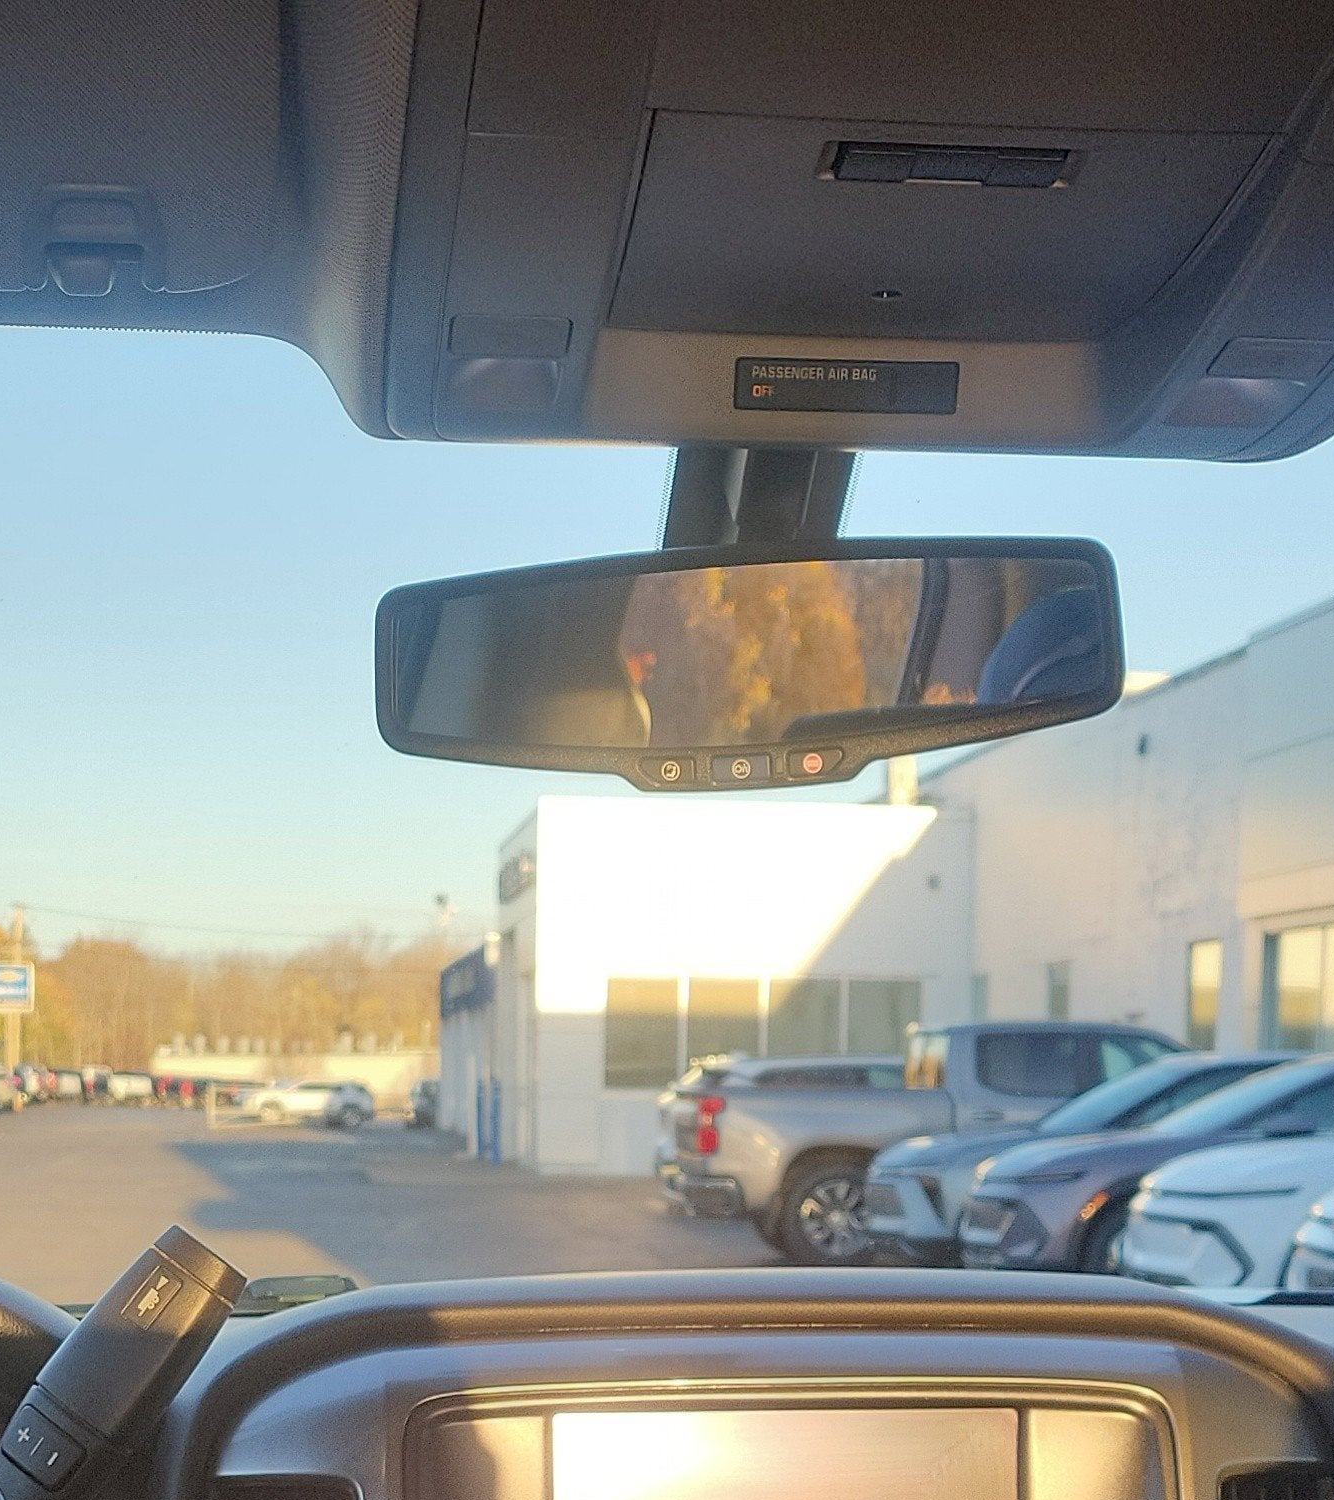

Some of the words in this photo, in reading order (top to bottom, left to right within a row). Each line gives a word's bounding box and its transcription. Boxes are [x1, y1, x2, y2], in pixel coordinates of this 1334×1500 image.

[752, 365, 823, 381] PASSENGER
[827, 367, 849, 381] AIR
[852, 368, 877, 382] BAG
[752, 384, 776, 398] OFF
